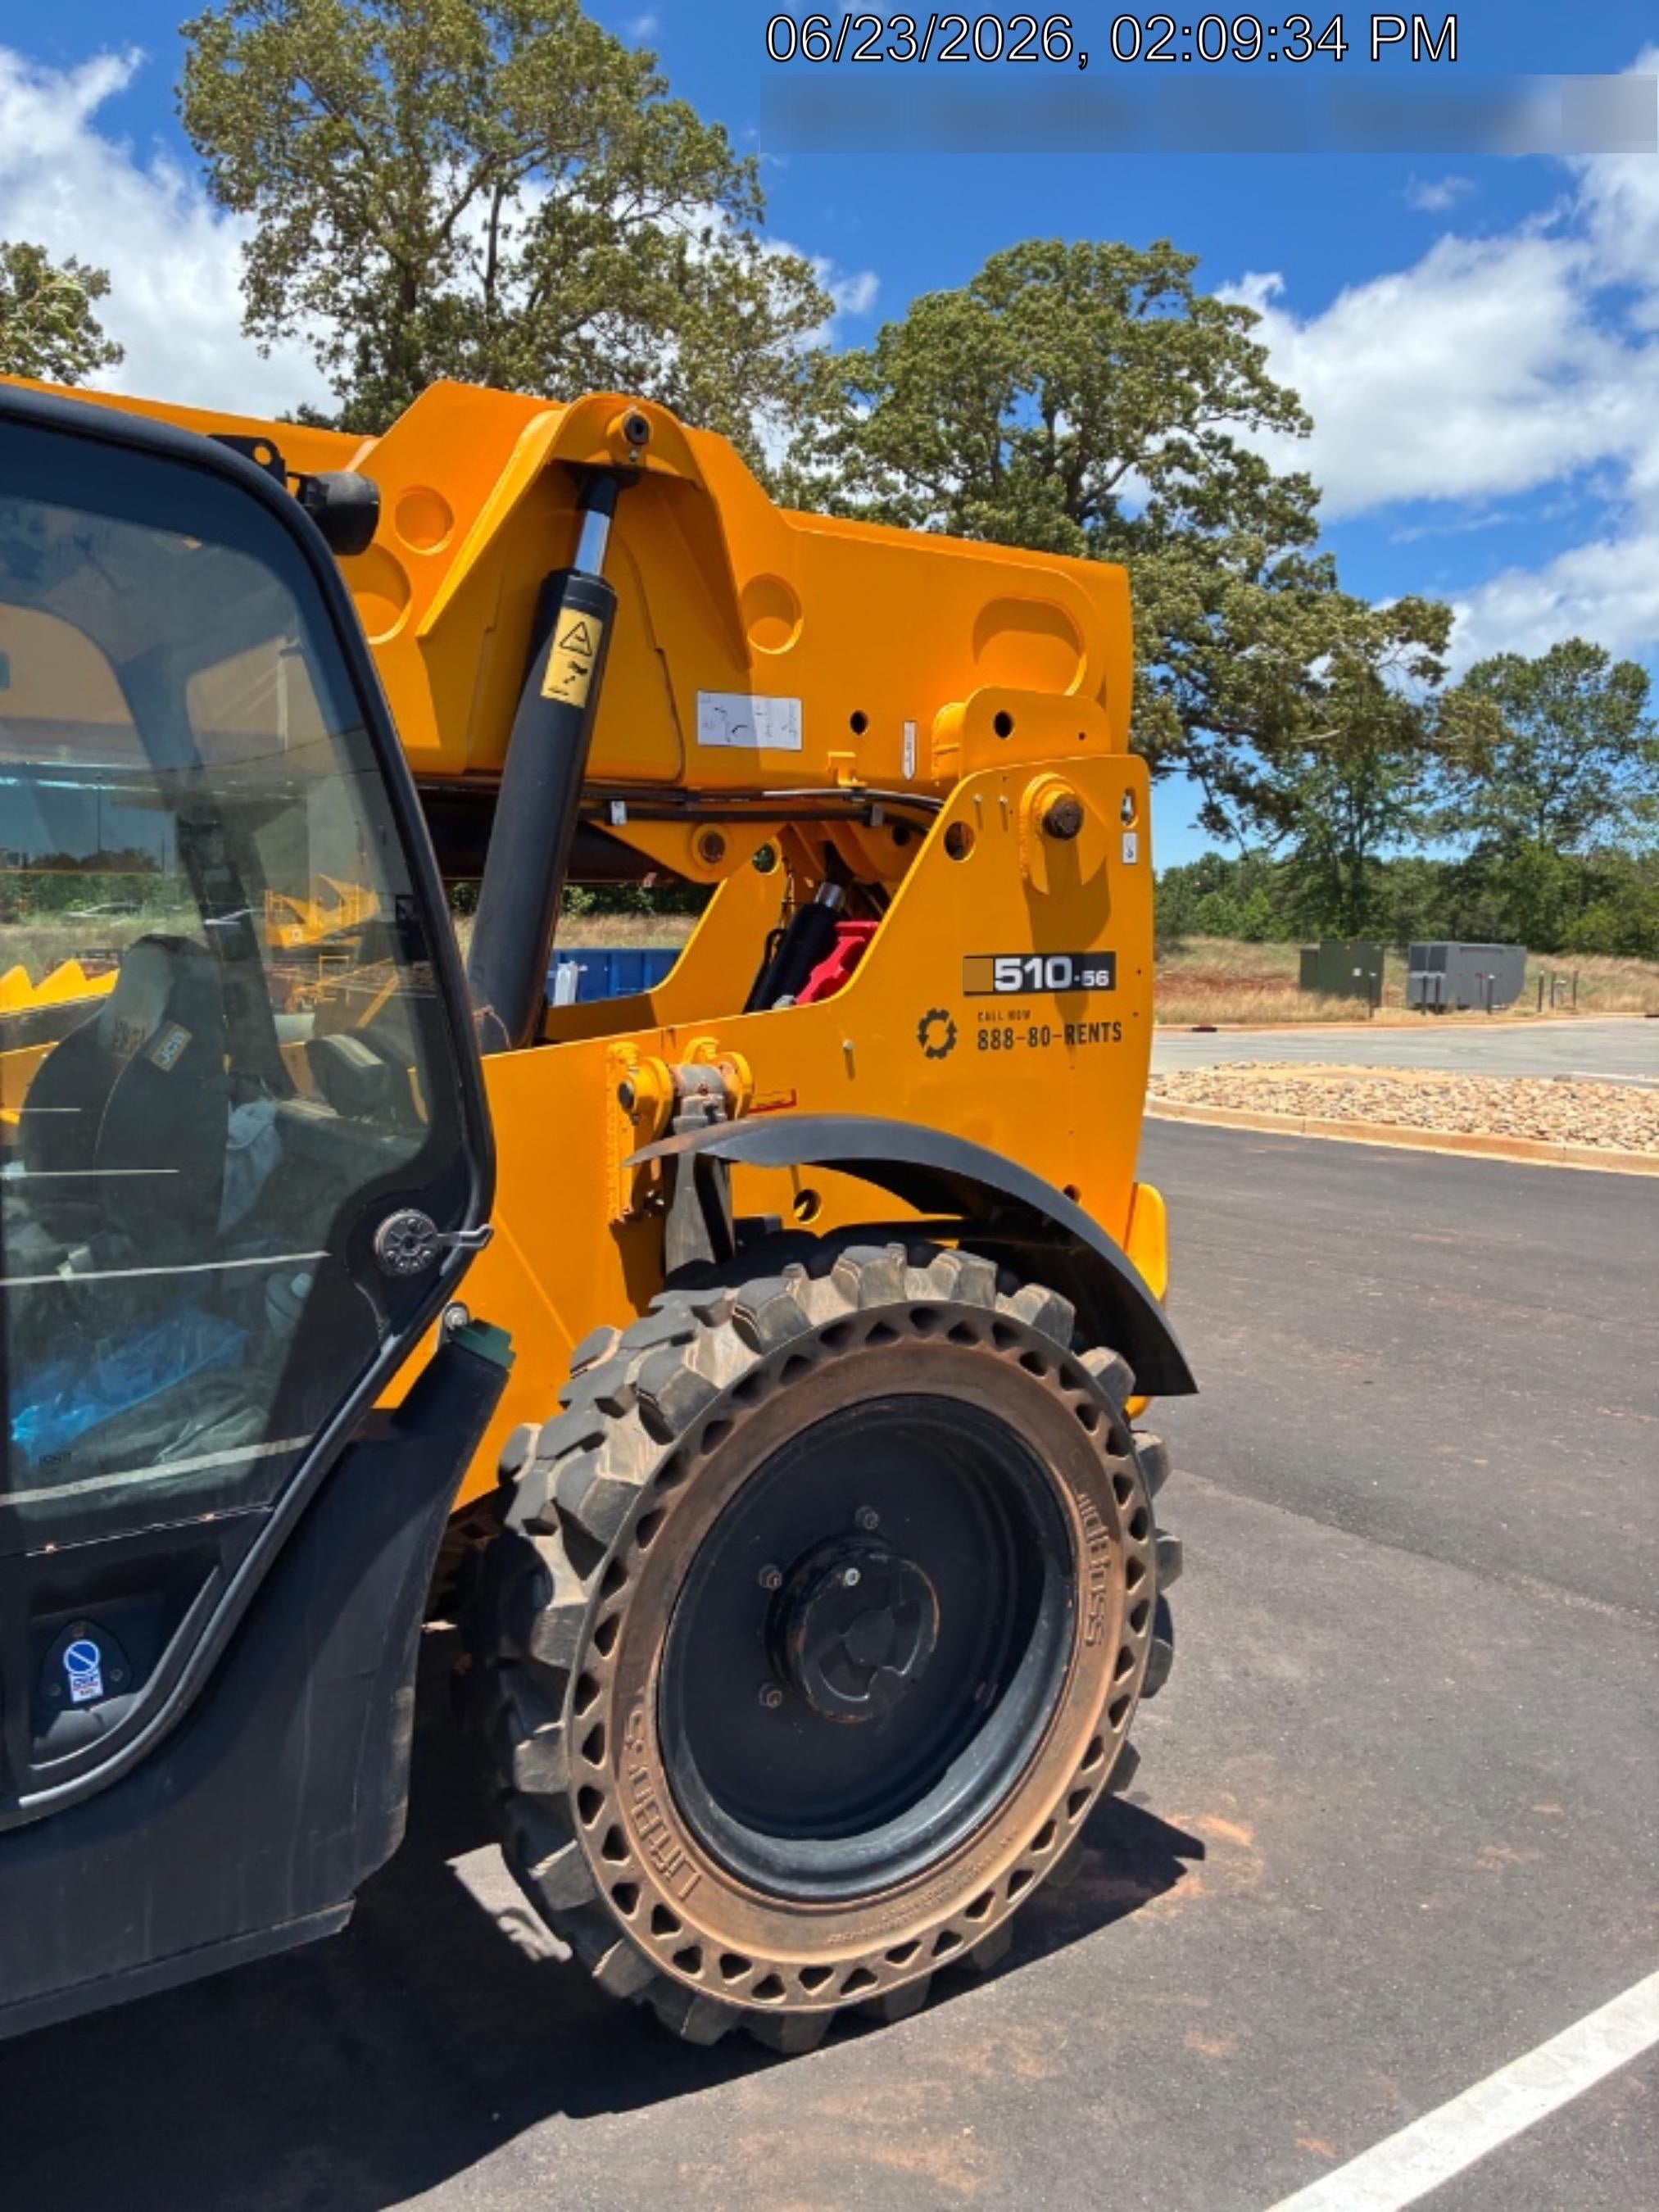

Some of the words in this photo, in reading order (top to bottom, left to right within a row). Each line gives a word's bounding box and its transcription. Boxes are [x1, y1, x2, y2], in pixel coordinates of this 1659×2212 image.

[994, 955, 1110, 992] 510-56
[977, 1011, 1004, 1022] CALL
[1008, 1009, 1031, 1022] NOW
[977, 1021, 1122, 1051] 888-80-RENTS
